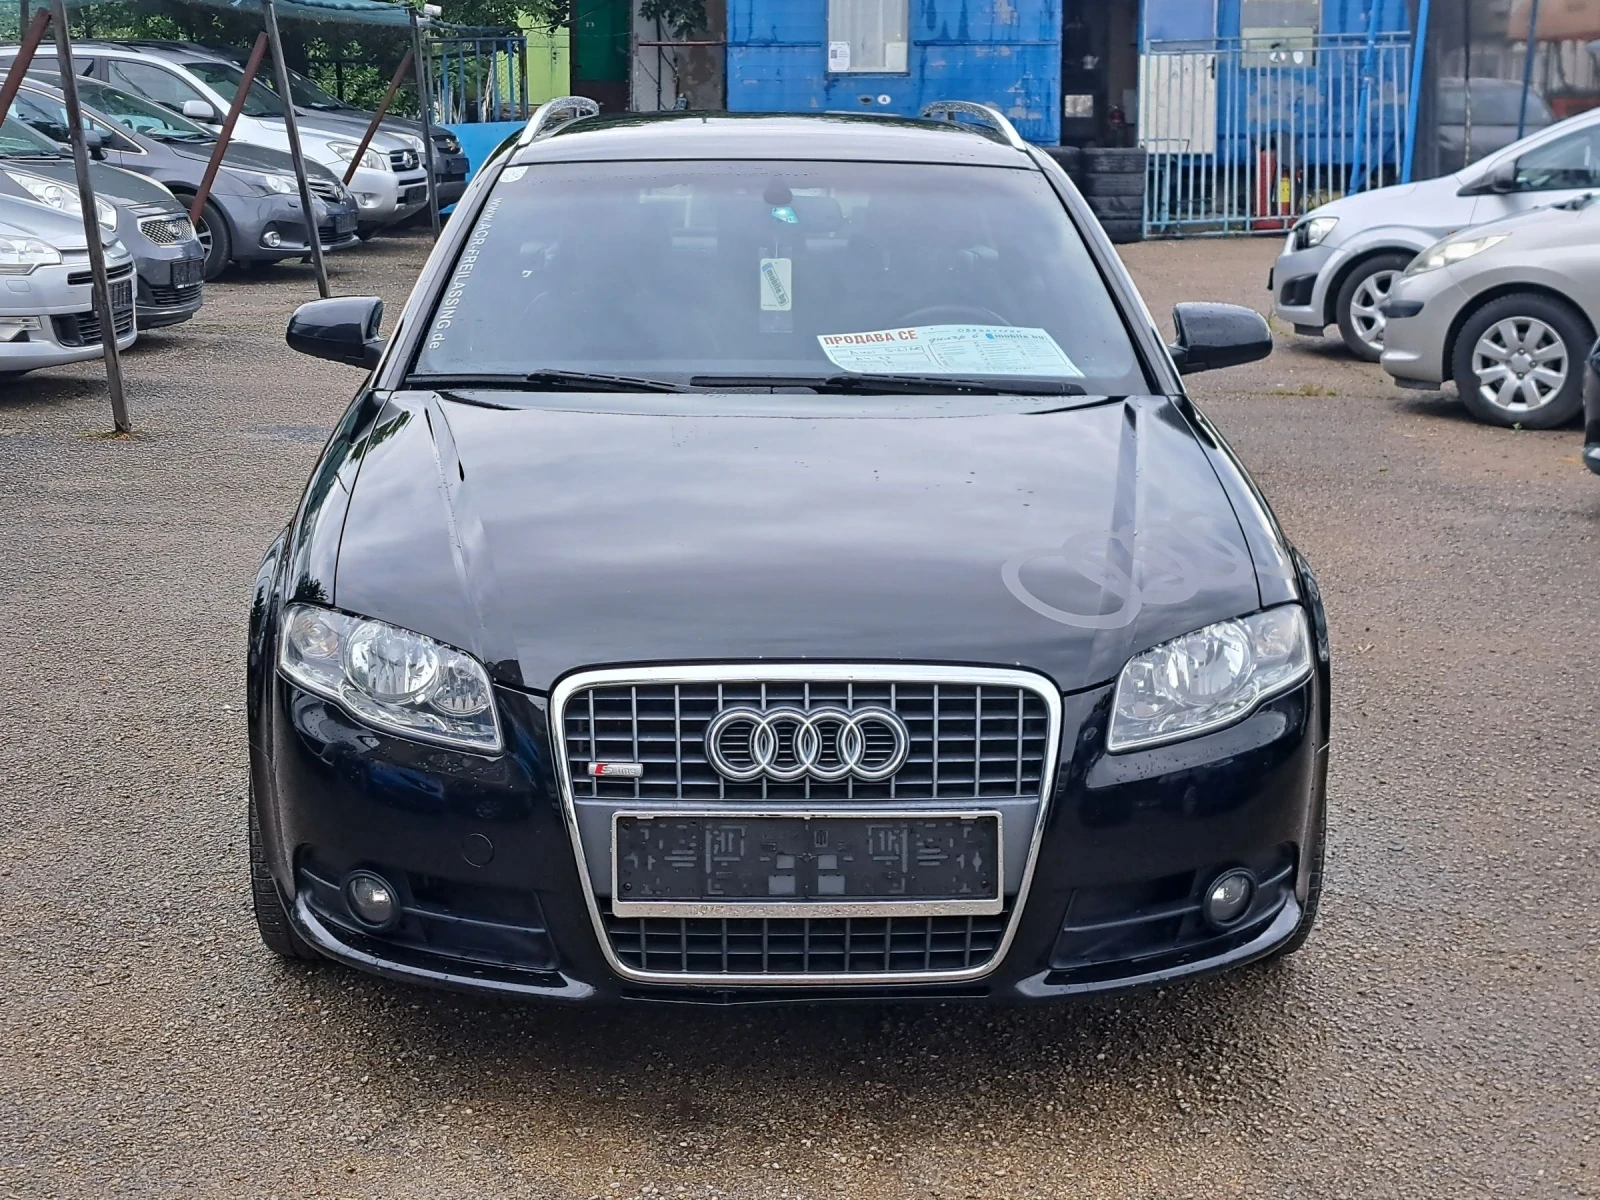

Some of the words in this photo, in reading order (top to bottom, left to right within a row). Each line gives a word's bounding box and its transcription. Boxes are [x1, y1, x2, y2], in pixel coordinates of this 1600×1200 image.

[767, 270, 786, 304] mobile.bg
[823, 332, 895, 345] ПРОДАВА
[898, 329, 918, 340] СЕ
[617, 766, 636, 775] line
